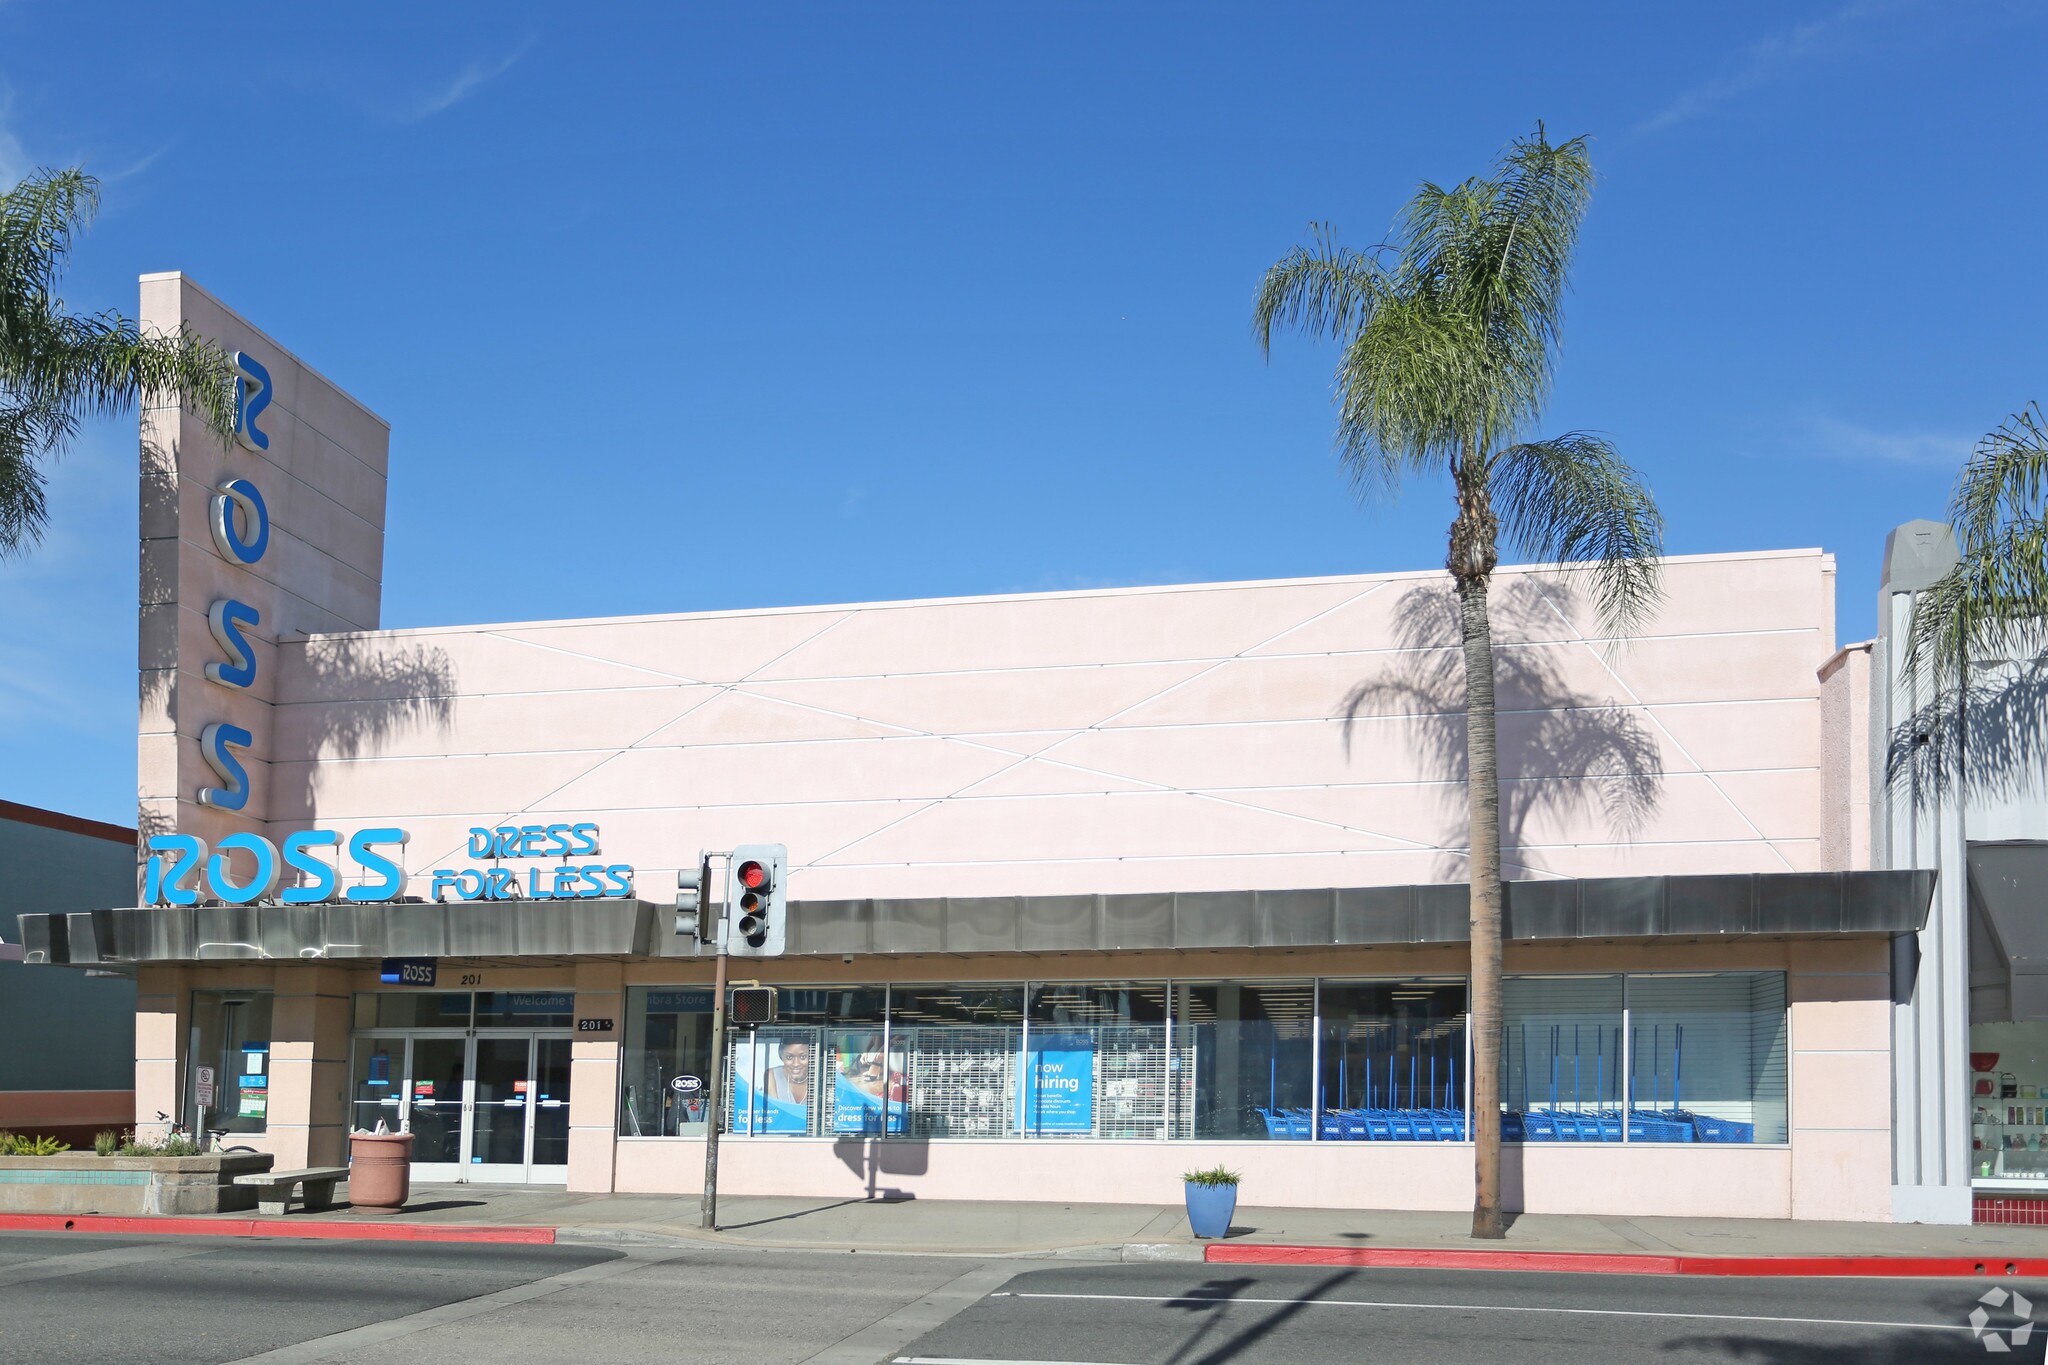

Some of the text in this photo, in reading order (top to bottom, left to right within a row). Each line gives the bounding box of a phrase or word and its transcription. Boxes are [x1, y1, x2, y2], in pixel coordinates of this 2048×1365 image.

[199, 351, 272, 811] ROSS
[468, 823, 599, 860] DRESS
[145, 828, 409, 906] ROSS
[431, 864, 634, 900] FOR LESS
[403, 964, 433, 982] ROSS
[460, 974, 482, 985] 201
[513, 994, 566, 1006] Welcome
[675, 993, 706, 1006] Store
[581, 1020, 601, 1030] 201
[1035, 1064, 1064, 1073] now
[675, 1080, 699, 1088] ROSS
[1034, 1075, 1079, 1092] hiring
[838, 1112, 897, 1122] dress for lss
